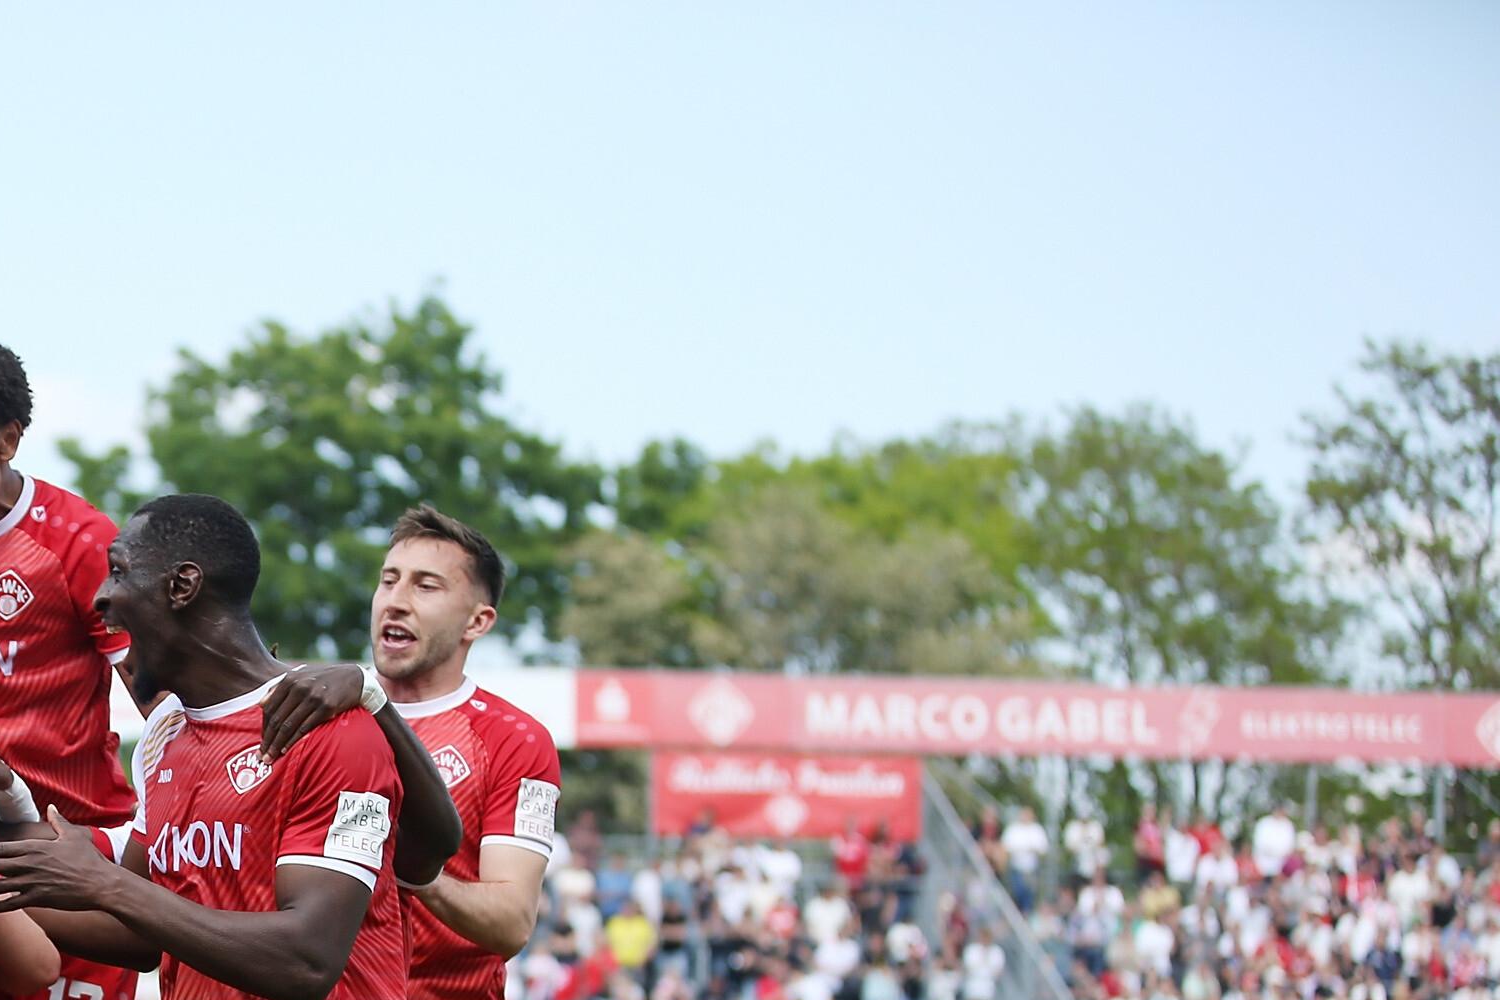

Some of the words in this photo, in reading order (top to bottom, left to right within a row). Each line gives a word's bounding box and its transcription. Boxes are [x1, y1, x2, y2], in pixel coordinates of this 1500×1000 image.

[805, 693, 988, 742] MARCO
[996, 694, 1157, 746] GABEL
[343, 798, 386, 815] MARC
[522, 800, 556, 818] GABE
[340, 814, 387, 833] GABEL
